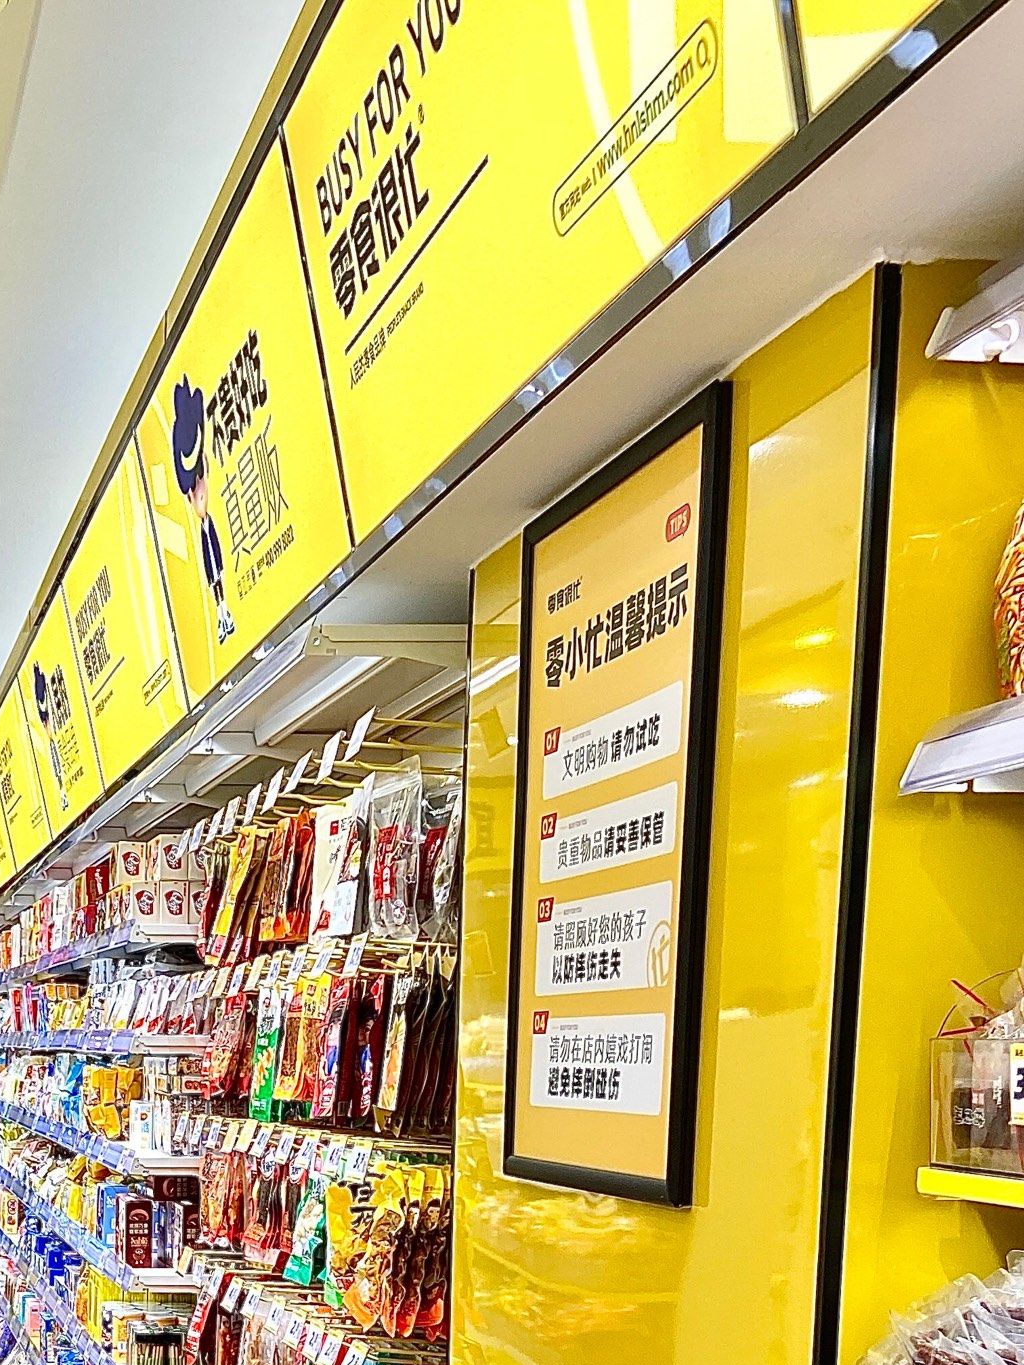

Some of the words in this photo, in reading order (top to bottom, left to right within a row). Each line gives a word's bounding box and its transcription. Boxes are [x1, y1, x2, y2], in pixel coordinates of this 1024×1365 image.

[316, 113, 361, 237] BUSY
[363, 43, 410, 157] FOR
[329, 122, 429, 319] 零食很忙
[669, 508, 688, 537] TIPS
[547, 578, 581, 614] 零食很忙
[546, 563, 689, 688] 零小忙温馨提示
[546, 731, 558, 750] 01
[542, 816, 554, 835] 02
[558, 811, 665, 870] 贵重物品请妥善保管
[539, 902, 551, 918] 03
[553, 909, 647, 951] 请照顾好您的孩子
[551, 948, 622, 984] 以防摔伤走失
[534, 1015, 546, 1032] 04
[549, 1034, 653, 1065] 请勿在店内嬉戏打闹
[547, 1066, 621, 1100] 避免摔倒碰伤
